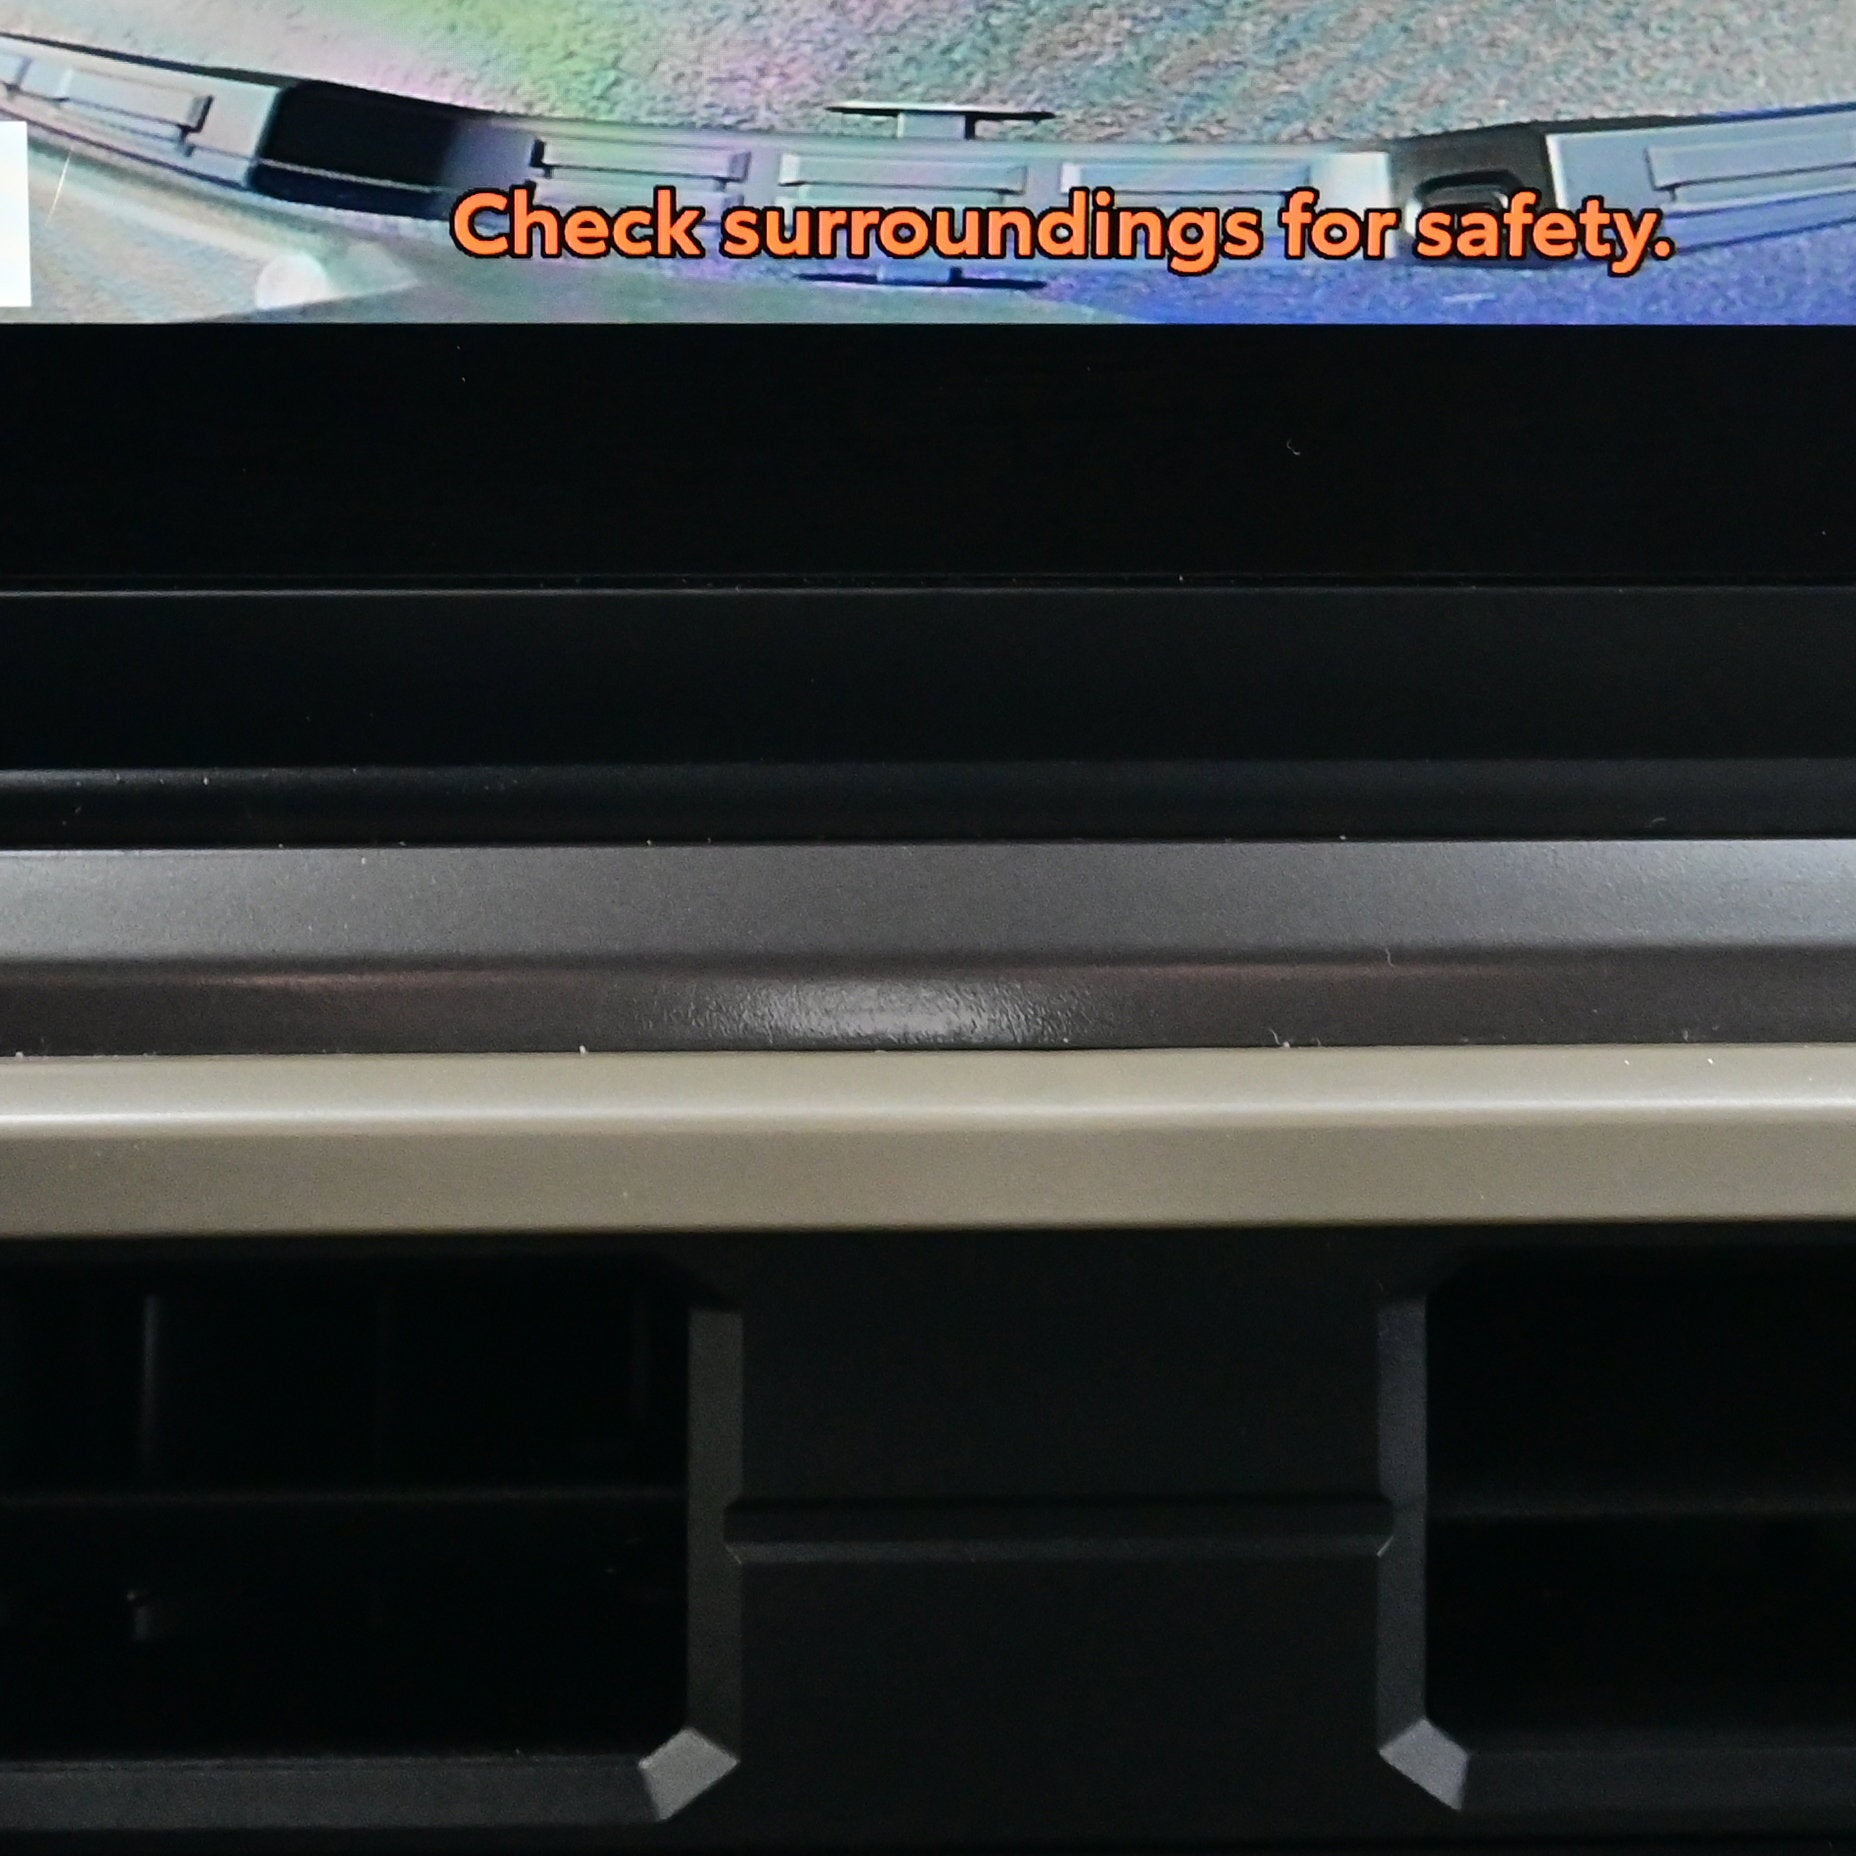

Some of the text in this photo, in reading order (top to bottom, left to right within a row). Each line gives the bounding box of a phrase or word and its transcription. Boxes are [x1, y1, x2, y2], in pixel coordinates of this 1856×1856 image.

[452, 186, 1672, 276] Check surroundings for safety.
